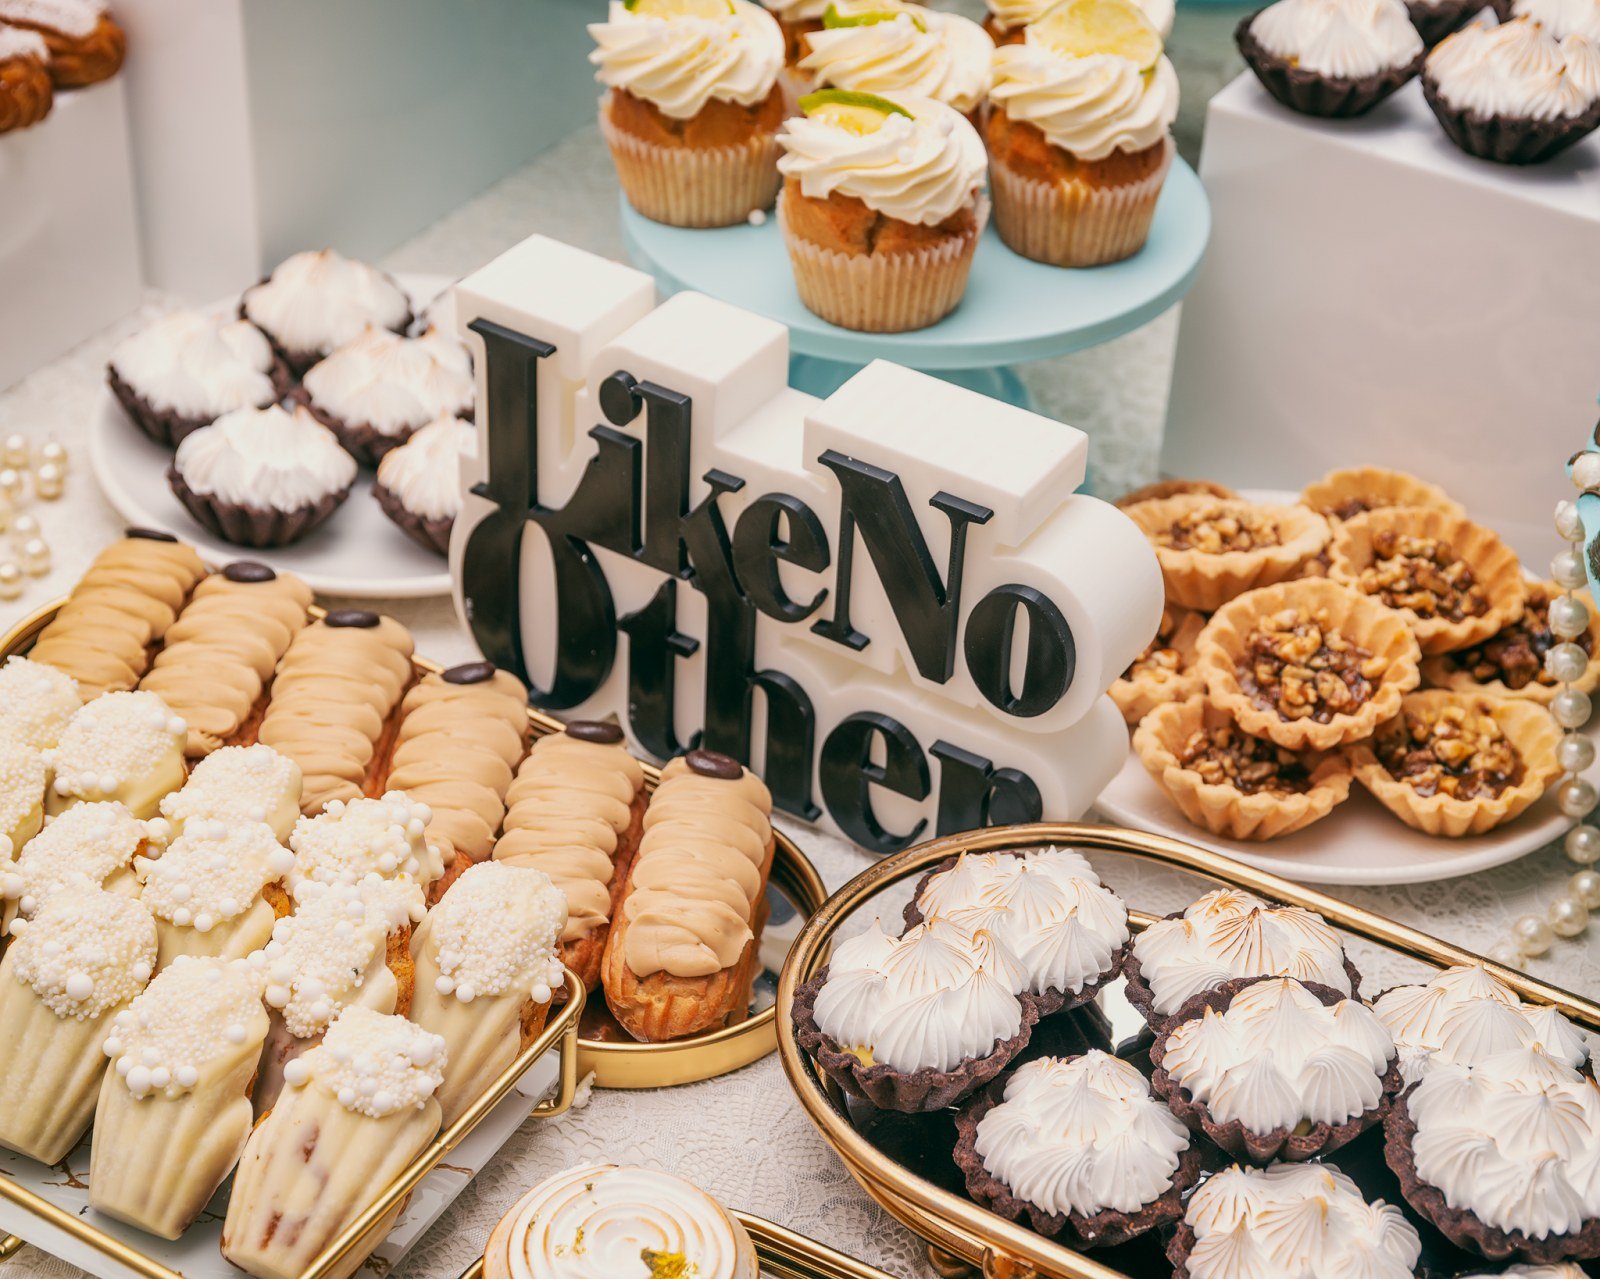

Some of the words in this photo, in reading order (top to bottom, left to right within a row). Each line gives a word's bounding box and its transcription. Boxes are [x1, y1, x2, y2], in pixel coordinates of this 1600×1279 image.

[462, 506, 1044, 854] Other
[468, 317, 831, 623] Like
[809, 448, 1077, 718] No
